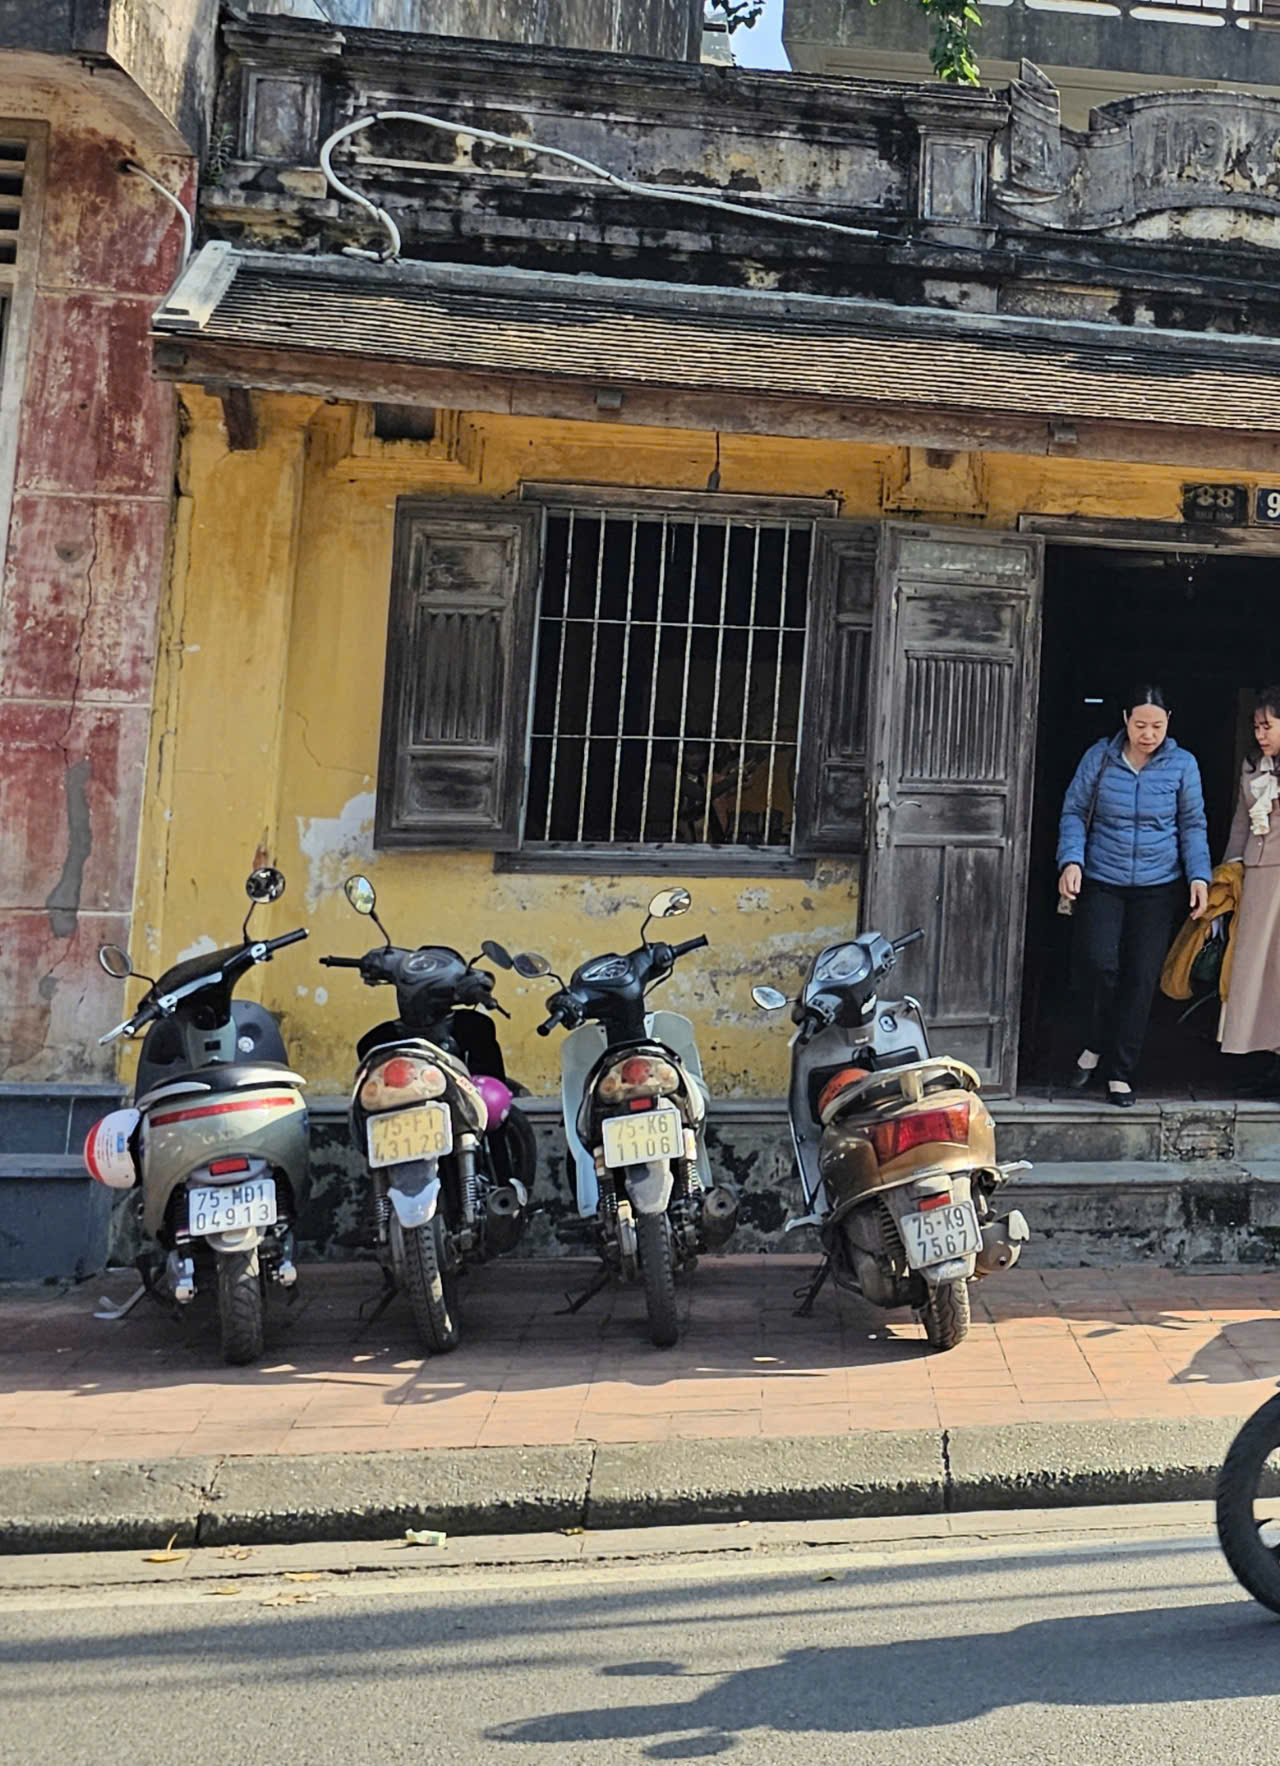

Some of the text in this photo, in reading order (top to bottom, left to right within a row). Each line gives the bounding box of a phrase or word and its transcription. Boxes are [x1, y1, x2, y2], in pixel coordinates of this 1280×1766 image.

[378, 1109, 434, 1140] 75-F1
[615, 1114, 669, 1141] 75-K6
[616, 1136, 671, 1161] 1106
[911, 1207, 965, 1240] 75-K9
[917, 1229, 968, 1263] 7567
